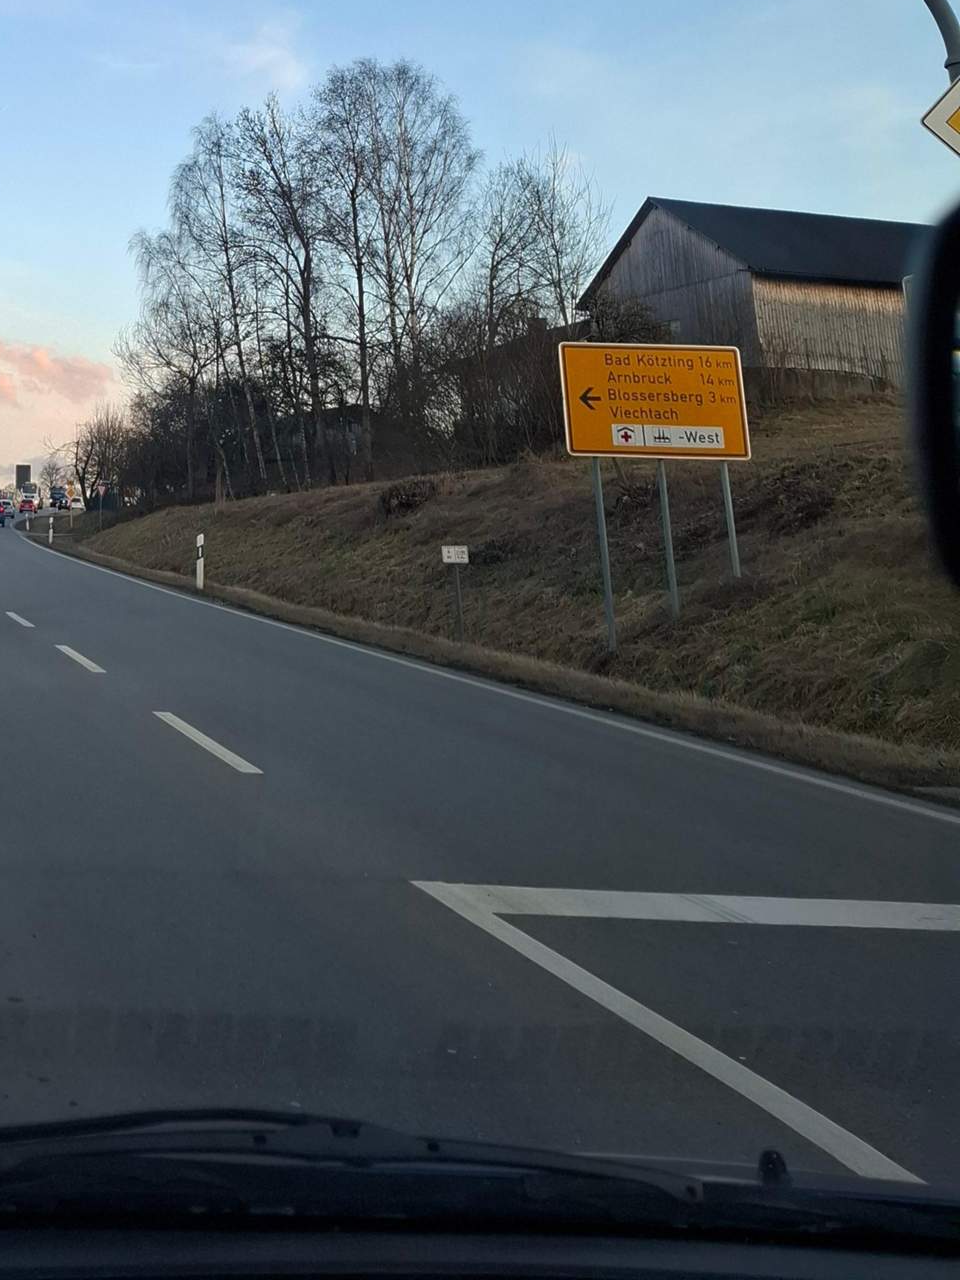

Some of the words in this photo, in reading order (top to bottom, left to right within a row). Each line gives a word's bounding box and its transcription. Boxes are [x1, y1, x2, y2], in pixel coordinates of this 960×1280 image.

[604, 353, 631, 367] Bad
[637, 353, 694, 372] Kötzting
[699, 356, 713, 369] 16
[716, 359, 732, 369] km
[607, 371, 672, 385] Arnbruck
[700, 373, 714, 386] 14
[718, 376, 735, 387] km
[608, 388, 703, 407] Blossersberg
[709, 391, 718, 404] 3
[720, 394, 737, 405] km
[610, 406, 678, 421] Viechtach
